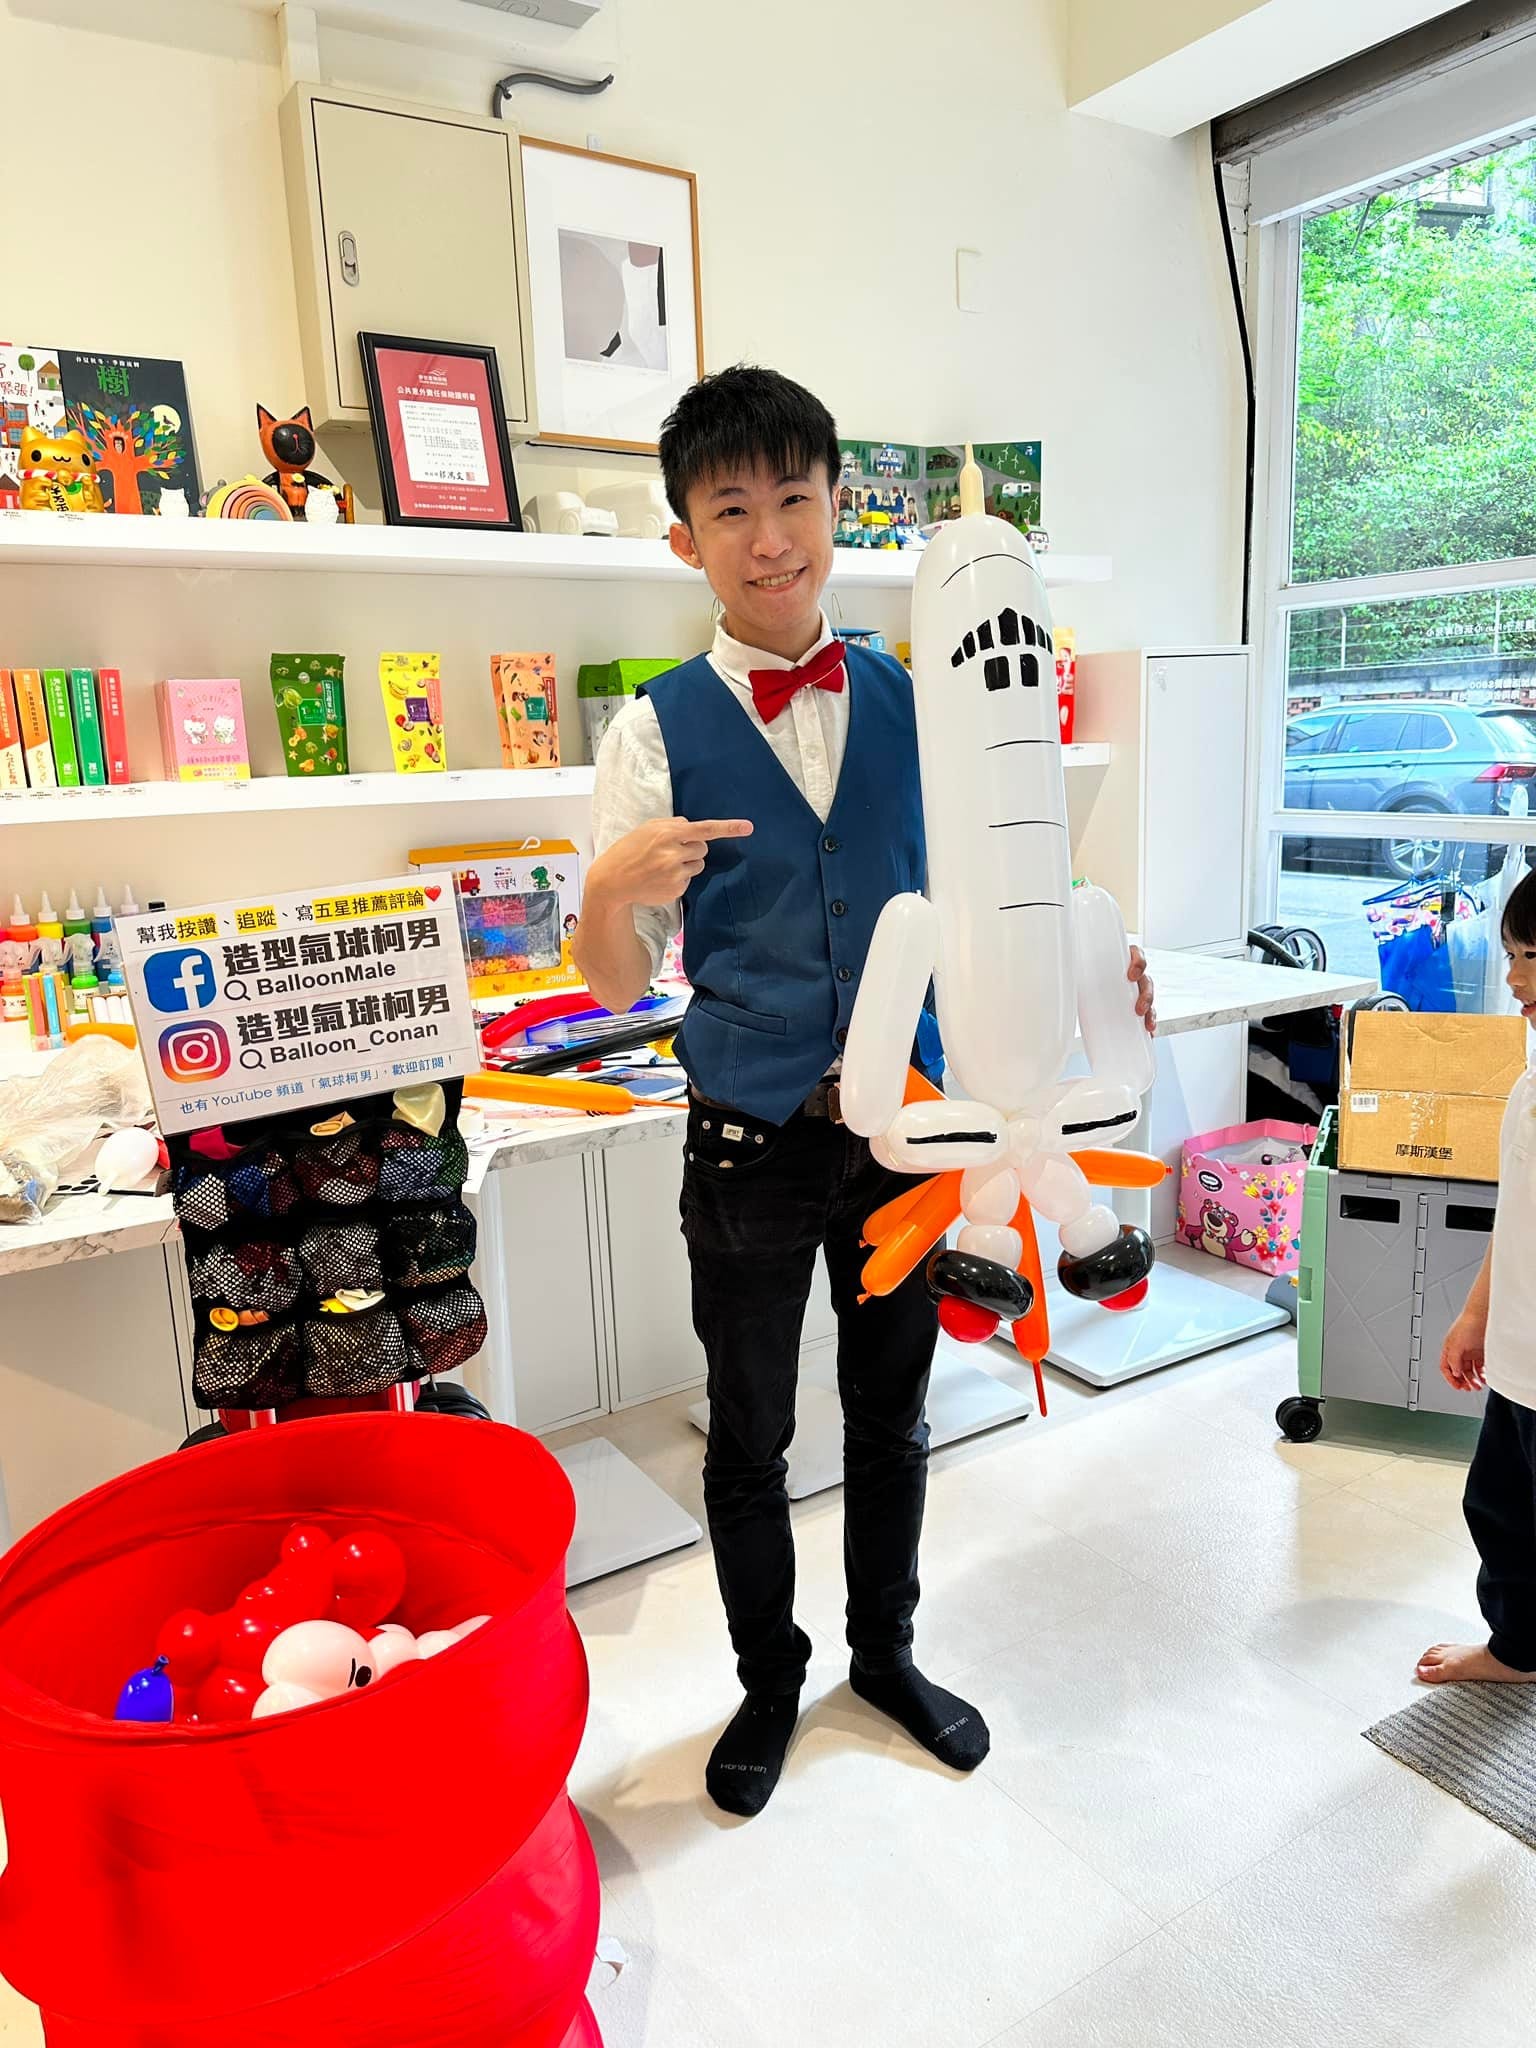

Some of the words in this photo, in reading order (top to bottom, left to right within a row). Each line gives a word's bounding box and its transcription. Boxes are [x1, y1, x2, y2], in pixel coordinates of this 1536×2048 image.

[96, 365, 130, 397] 樹
[222, 917, 441, 977] 造型氣球柯男
[256, 961, 396, 996] BalloonMale
[236, 983, 450, 1046] 造型氣球柯男
[270, 1023, 439, 1063] Balloon_Conan
[180, 1098, 208, 1114] 也有
[212, 1088, 273, 1107] YouTube
[1395, 1143, 1454, 1160] 摩斯漢堡
